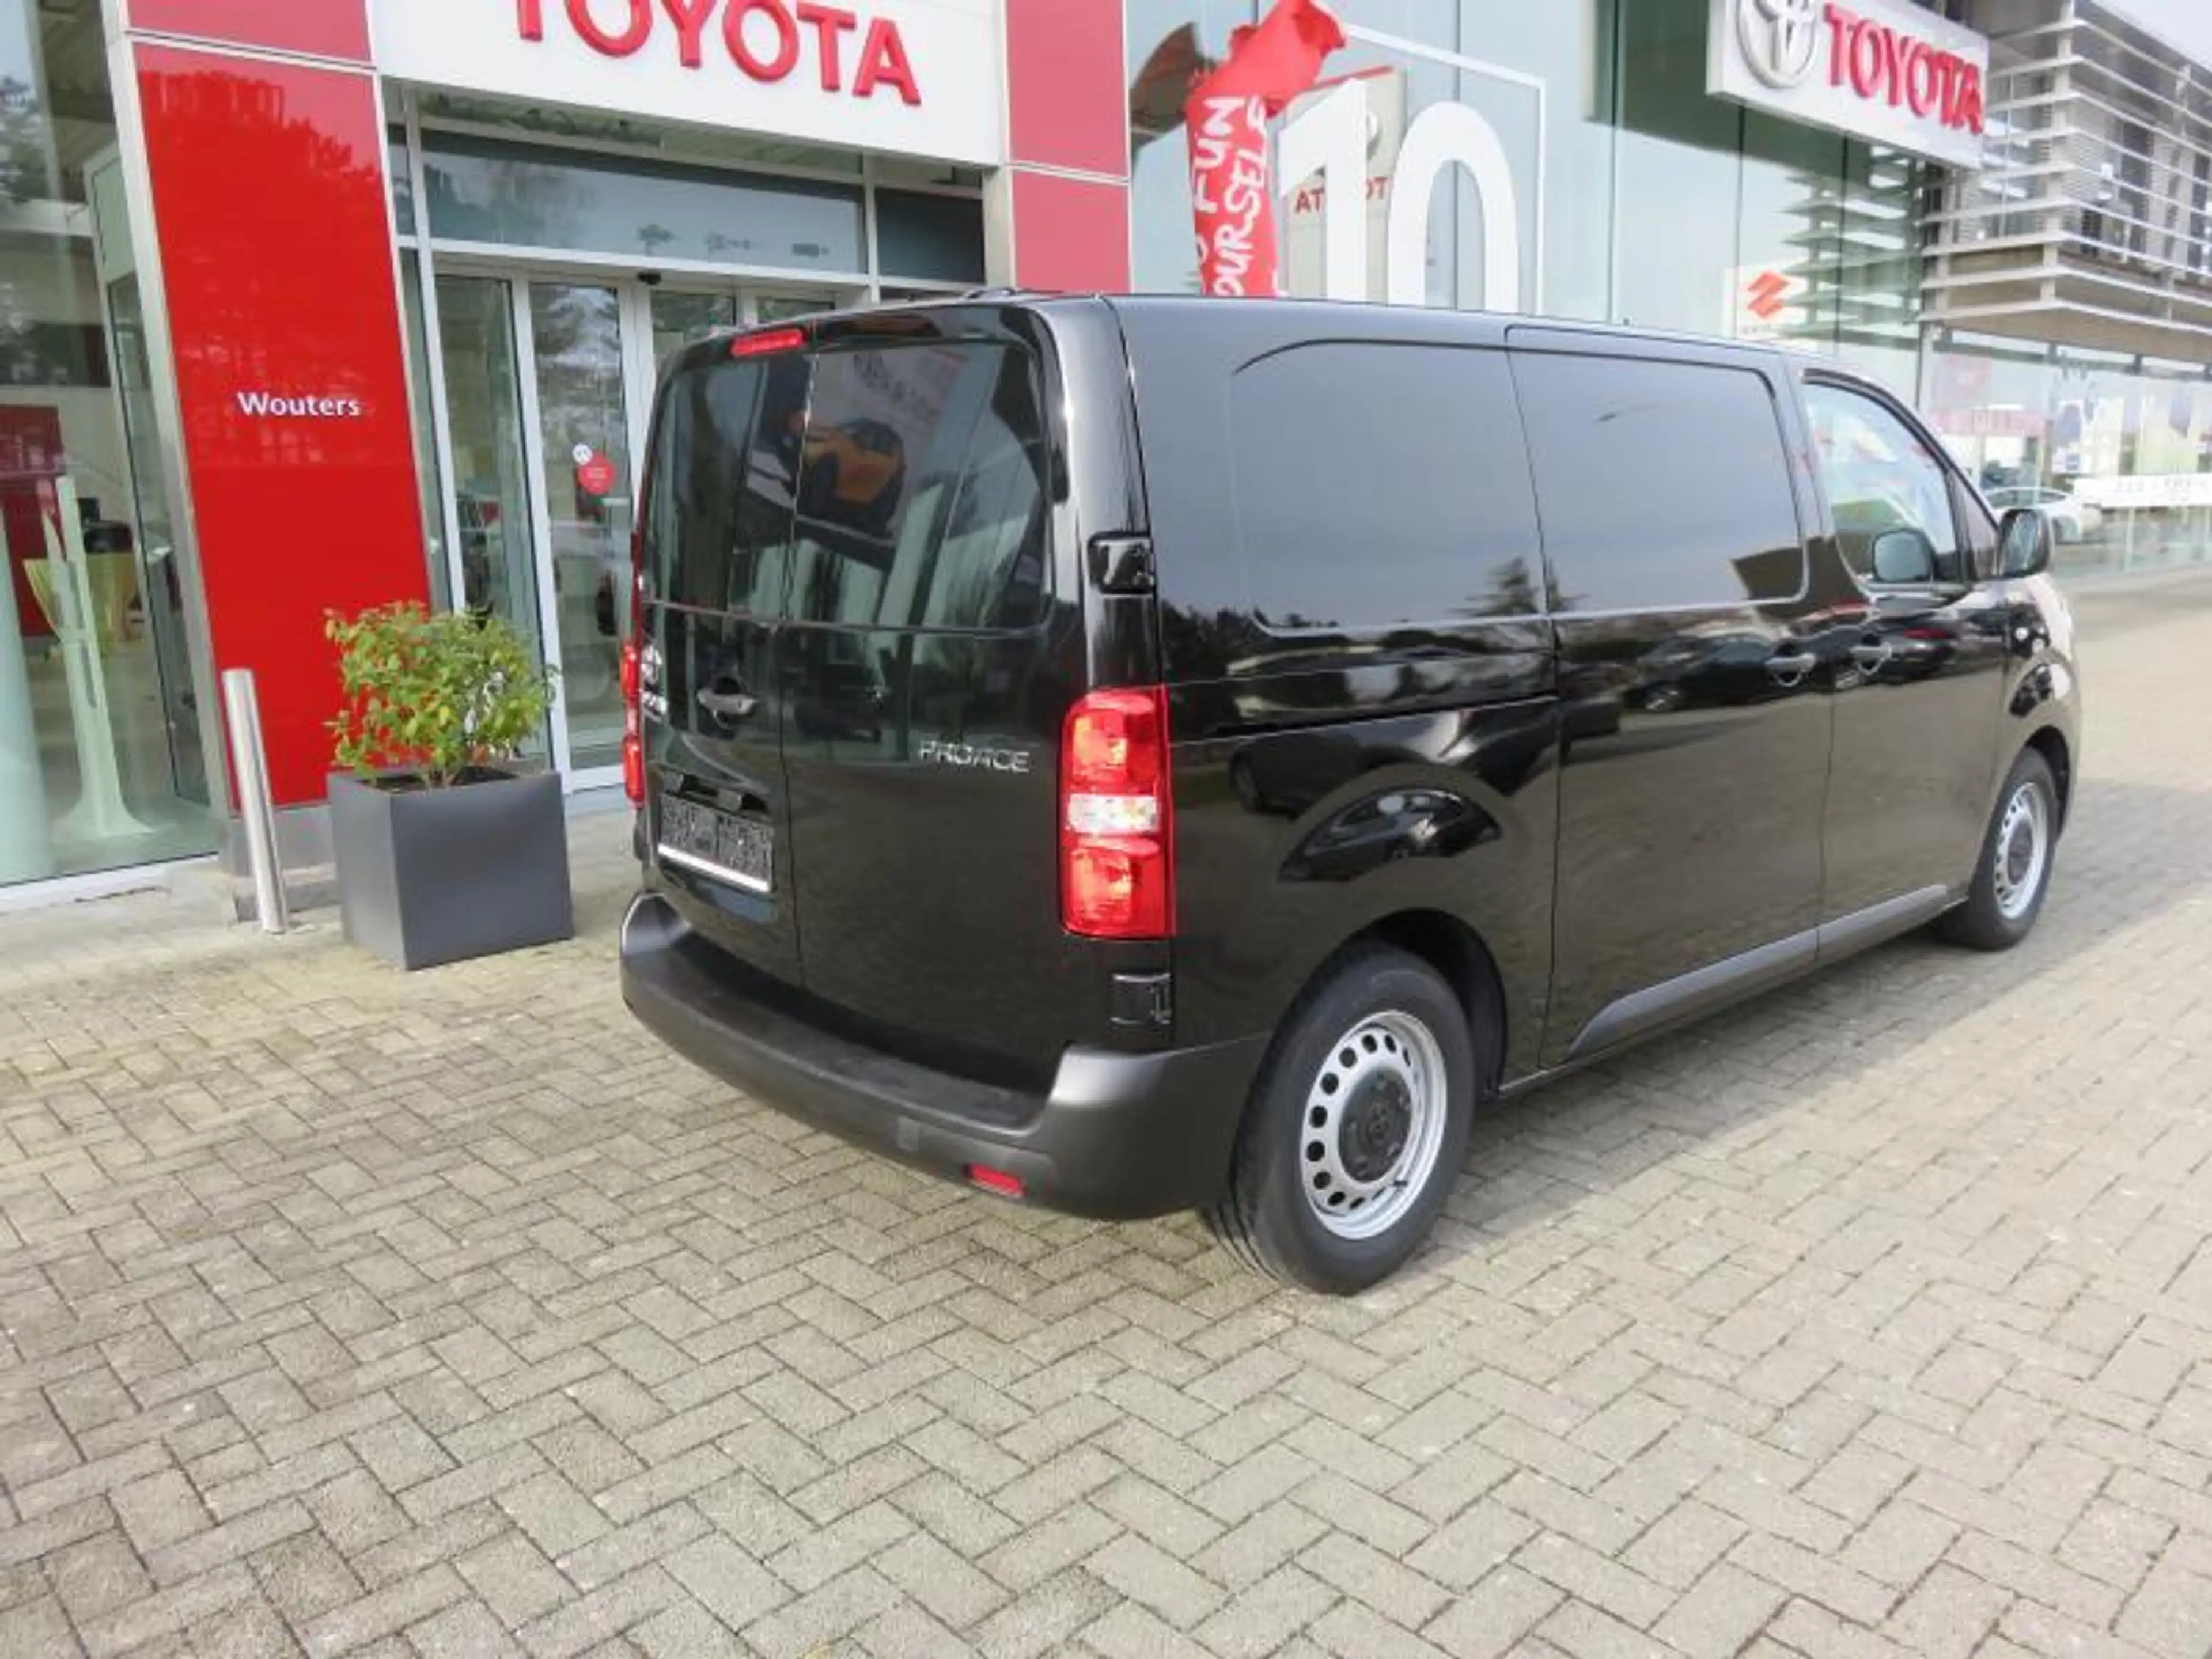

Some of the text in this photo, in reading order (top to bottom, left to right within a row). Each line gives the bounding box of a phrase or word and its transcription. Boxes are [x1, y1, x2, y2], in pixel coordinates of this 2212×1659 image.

[1823, 2, 1983, 135] TOYOTA
[1213, 93, 1267, 296] OURSELF
[237, 391, 360, 416] Wouters
[920, 740, 1030, 773] PROACE
